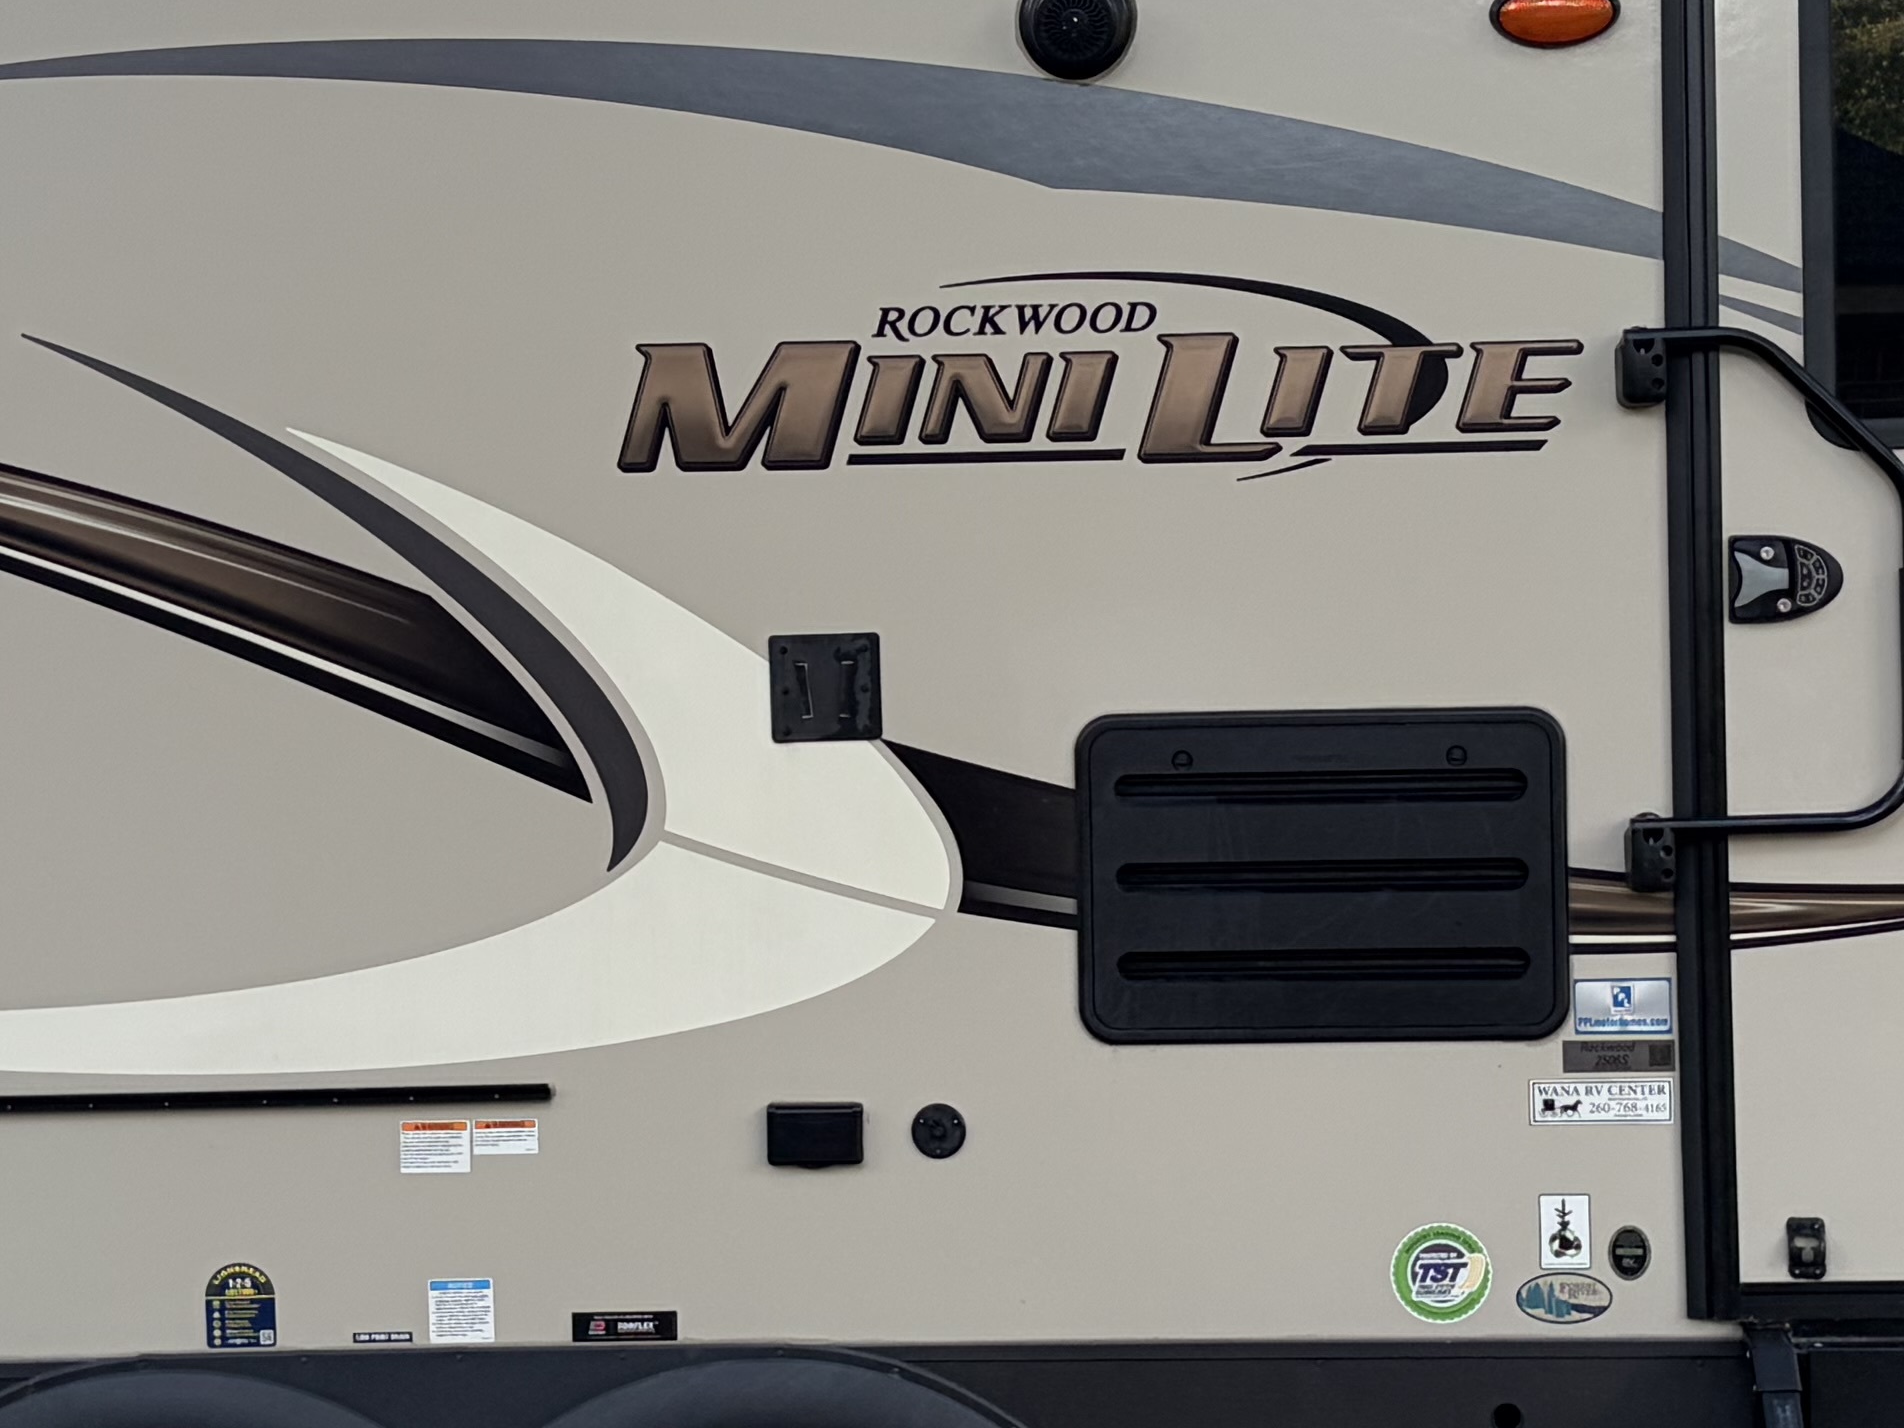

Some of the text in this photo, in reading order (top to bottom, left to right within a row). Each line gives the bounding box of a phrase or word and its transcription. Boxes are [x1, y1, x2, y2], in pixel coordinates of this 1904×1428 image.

[871, 301, 1158, 341] ROCKWOOD
[617, 332, 1584, 473] MINI LITE
[1537, 1084, 1667, 1097] WANA RV CENTER
[1418, 1262, 1469, 1283] TST
